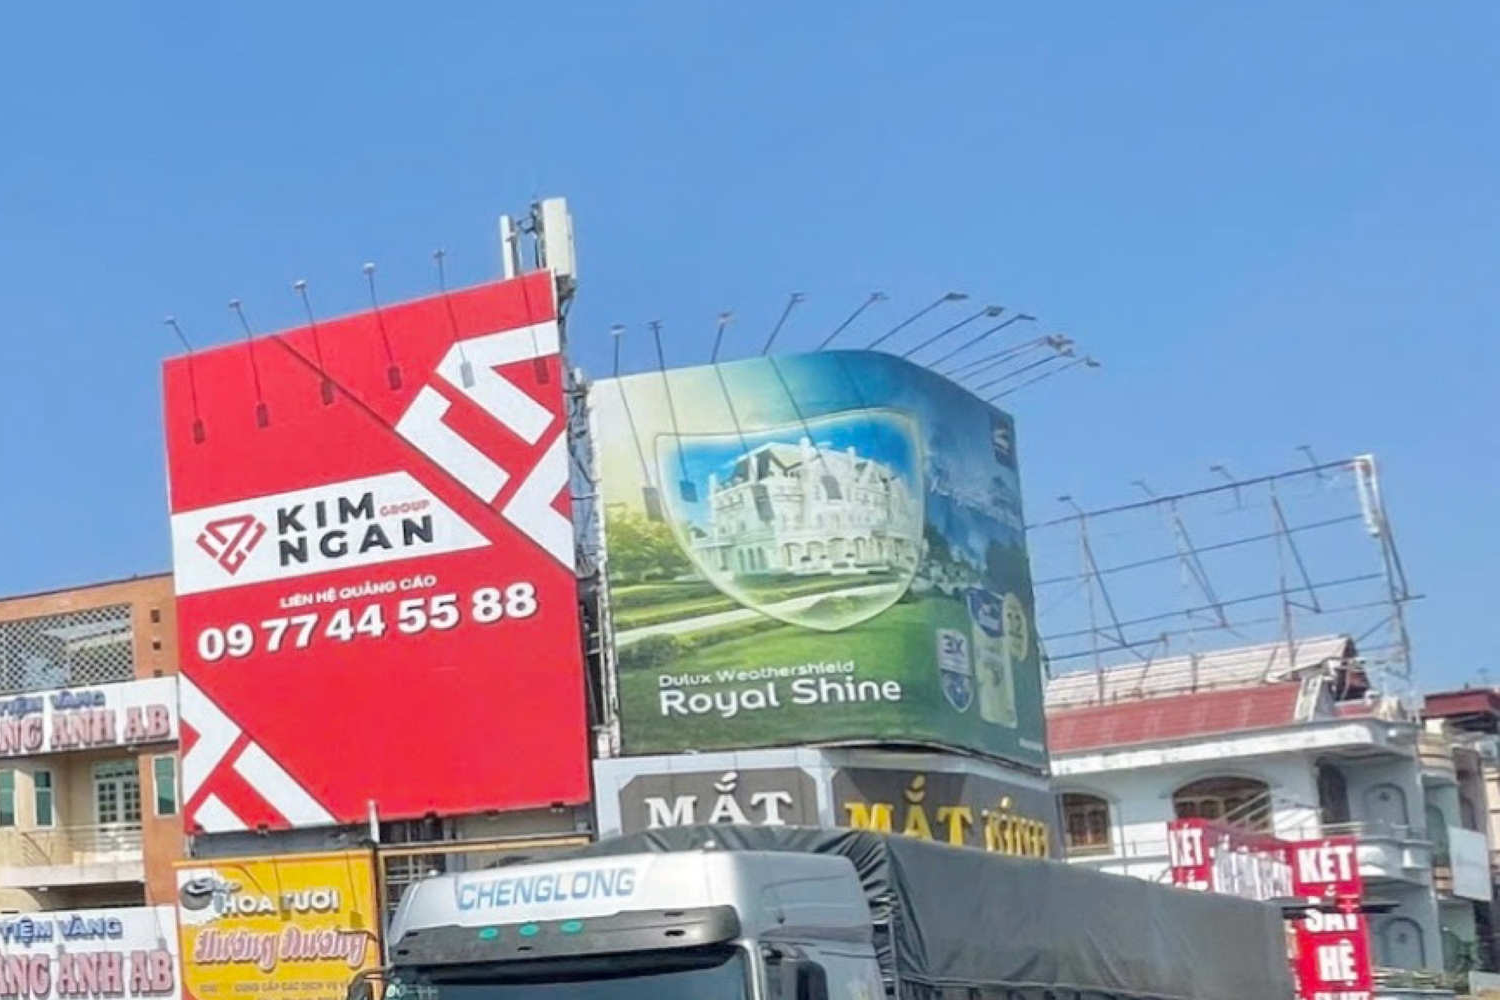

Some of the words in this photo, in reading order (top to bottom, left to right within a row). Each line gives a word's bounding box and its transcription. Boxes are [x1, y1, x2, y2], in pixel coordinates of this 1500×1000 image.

[277, 492, 375, 535] KIM
[380, 499, 430, 517] GROUP
[279, 514, 434, 567] NGAN
[280, 592, 313, 609] LIÊN
[316, 586, 337, 606] HỆ
[339, 579, 396, 601] QUẢNG
[399, 574, 438, 592] CÁO
[198, 622, 254, 663] 09
[261, 613, 320, 652] 77
[325, 603, 386, 643] 44
[398, 593, 461, 634] 55
[471, 581, 539, 624] 88
[658, 673, 712, 689] Dulux
[715, 660, 855, 683] Weathershield
[659, 685, 780, 719] Royal
[792, 674, 902, 705] Shine
[49, 709, 117, 749] ANH
[125, 703, 171, 741] AB
[644, 772, 793, 829] MẮT
[843, 773, 974, 847] MẮT
[1296, 840, 1355, 884] KÉT
[220, 894, 277, 917] HOA
[457, 866, 636, 912] CHENGLONG
[56, 913, 123, 942] VÀNG
[57, 951, 125, 999] ANH
[130, 949, 174, 997] AB
[1317, 939, 1357, 986] HỆ
